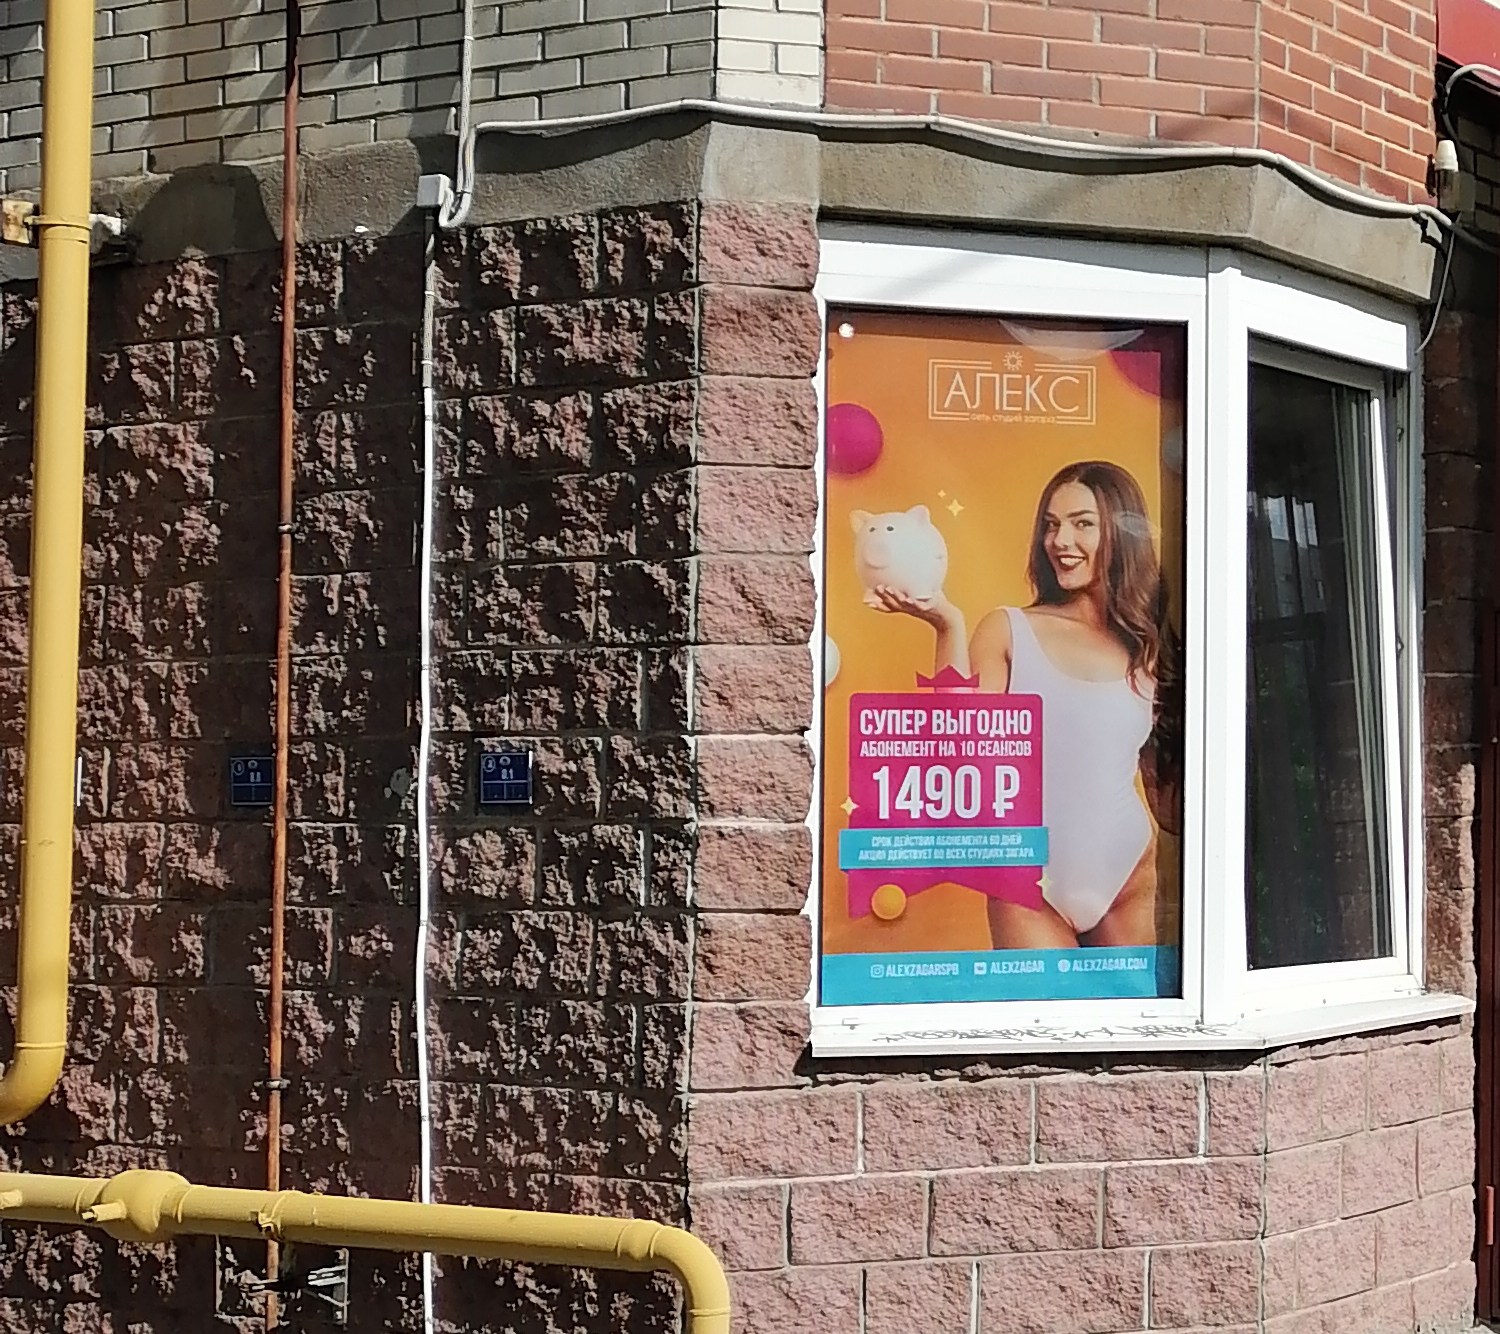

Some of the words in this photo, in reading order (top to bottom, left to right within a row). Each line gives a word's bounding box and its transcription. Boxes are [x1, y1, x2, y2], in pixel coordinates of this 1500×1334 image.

[943, 371, 1081, 413] АЛЕКС
[859, 709, 928, 735] СУПЕР
[931, 708, 1033, 738] ВЫГОДНО
[859, 740, 937, 757] АБОНЕМЕНТ
[938, 740, 957, 757] НА
[960, 740, 976, 757] 10
[977, 740, 1033, 757] СЕАНСОВ
[872, 765, 982, 820] 1490
[990, 960, 1045, 974] ALEXZAGAR
